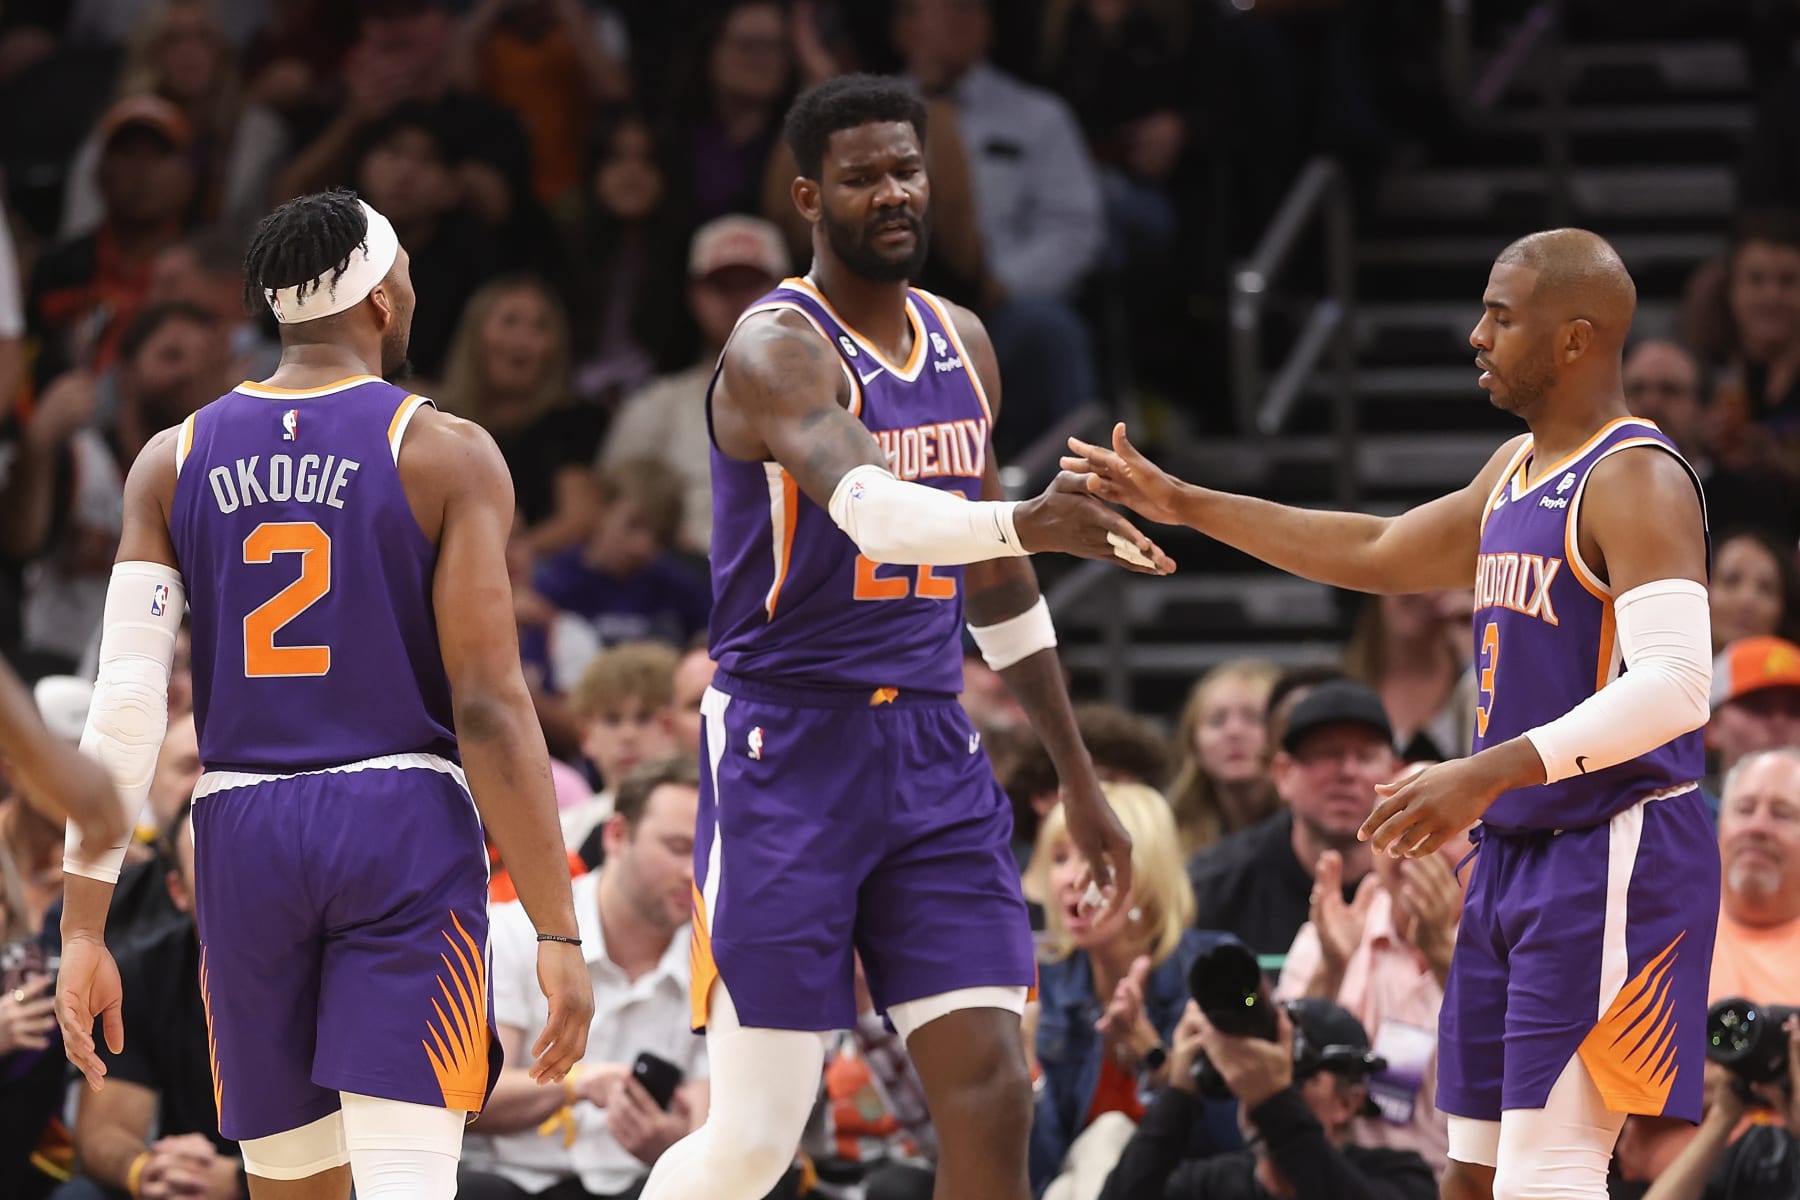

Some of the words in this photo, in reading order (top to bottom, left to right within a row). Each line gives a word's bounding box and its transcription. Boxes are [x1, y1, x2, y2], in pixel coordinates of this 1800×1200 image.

[838, 335, 858, 357] 6
[871, 418, 985, 481] HOENIX
[208, 454, 360, 514] OKOGIE
[243, 522, 331, 677] 2
[1474, 552, 1562, 626] HOENIX
[1476, 622, 1499, 737] 3
